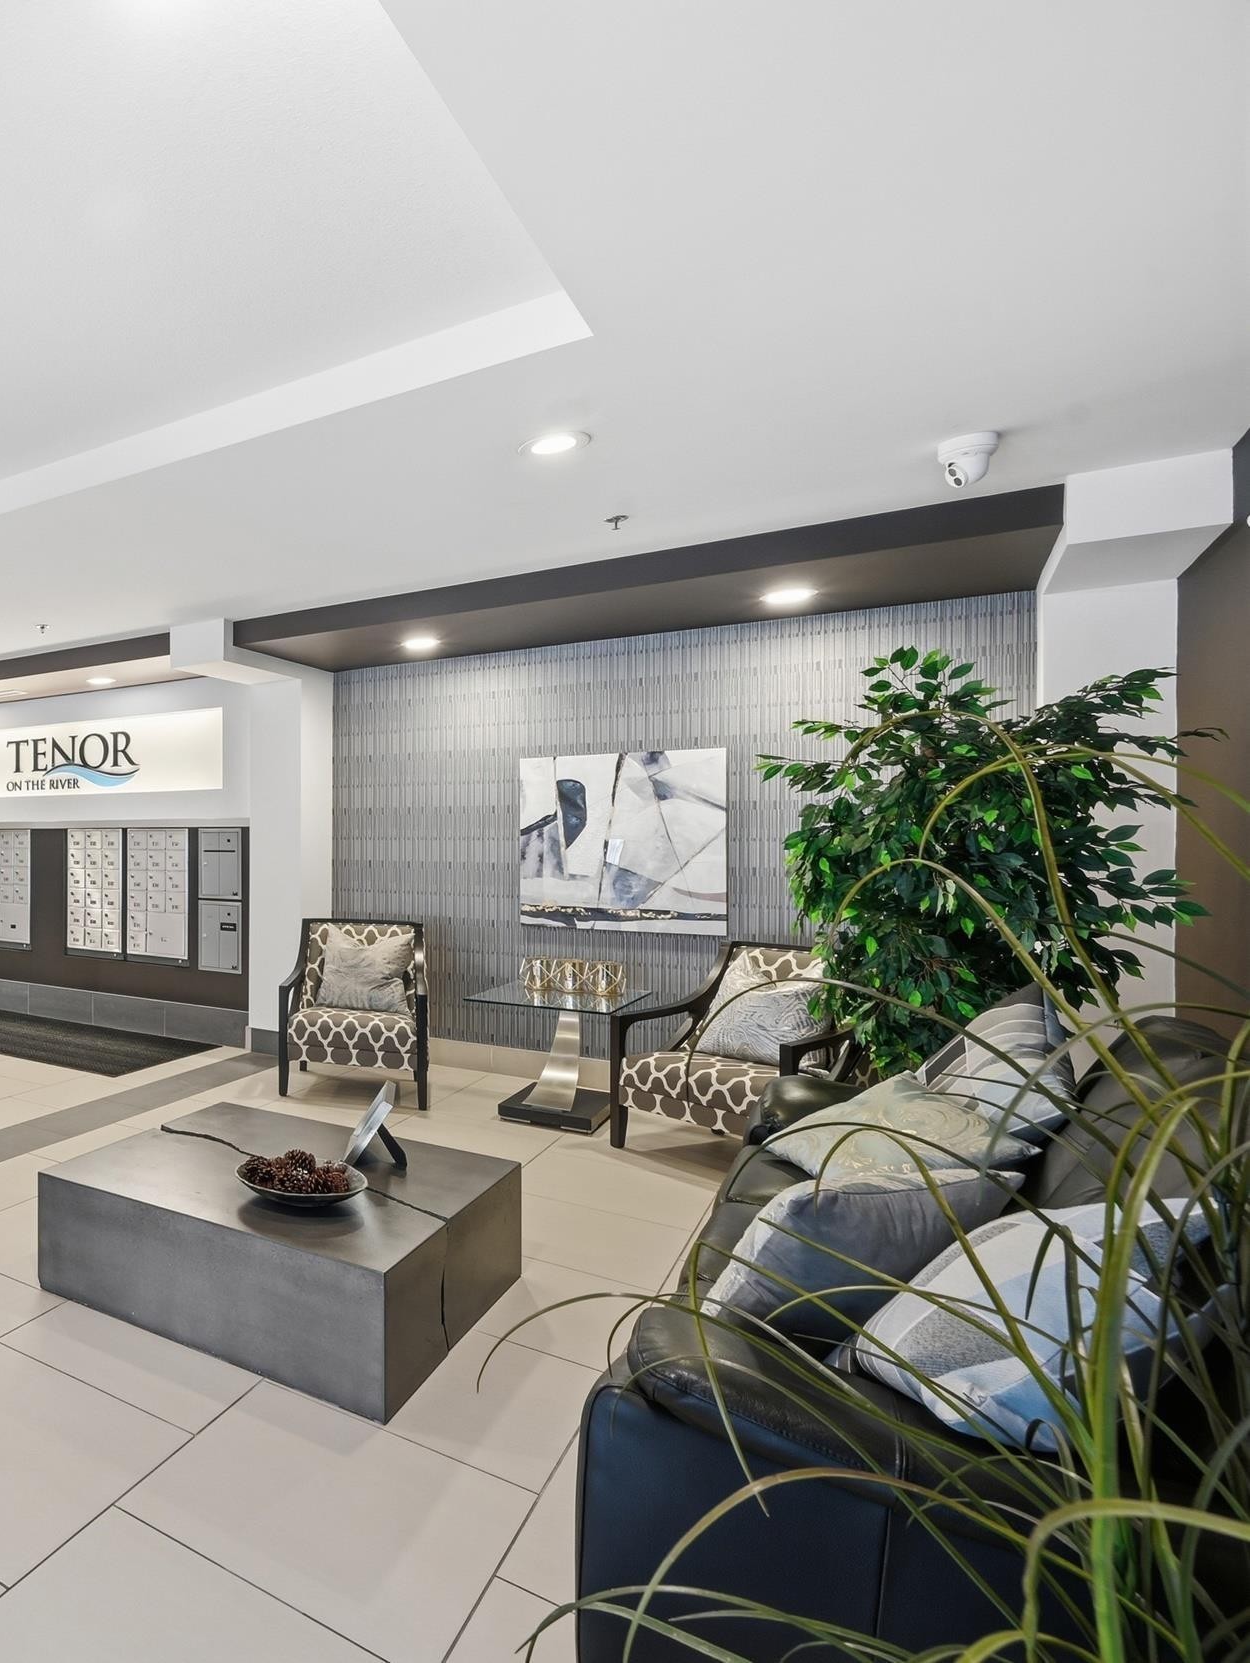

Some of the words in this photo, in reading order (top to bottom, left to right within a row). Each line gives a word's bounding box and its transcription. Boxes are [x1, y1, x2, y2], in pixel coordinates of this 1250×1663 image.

[6, 731, 140, 774] TENOR
[6, 781, 22, 792] ON
[25, 778, 46, 791] THE
[49, 778, 80, 790] RIVER
